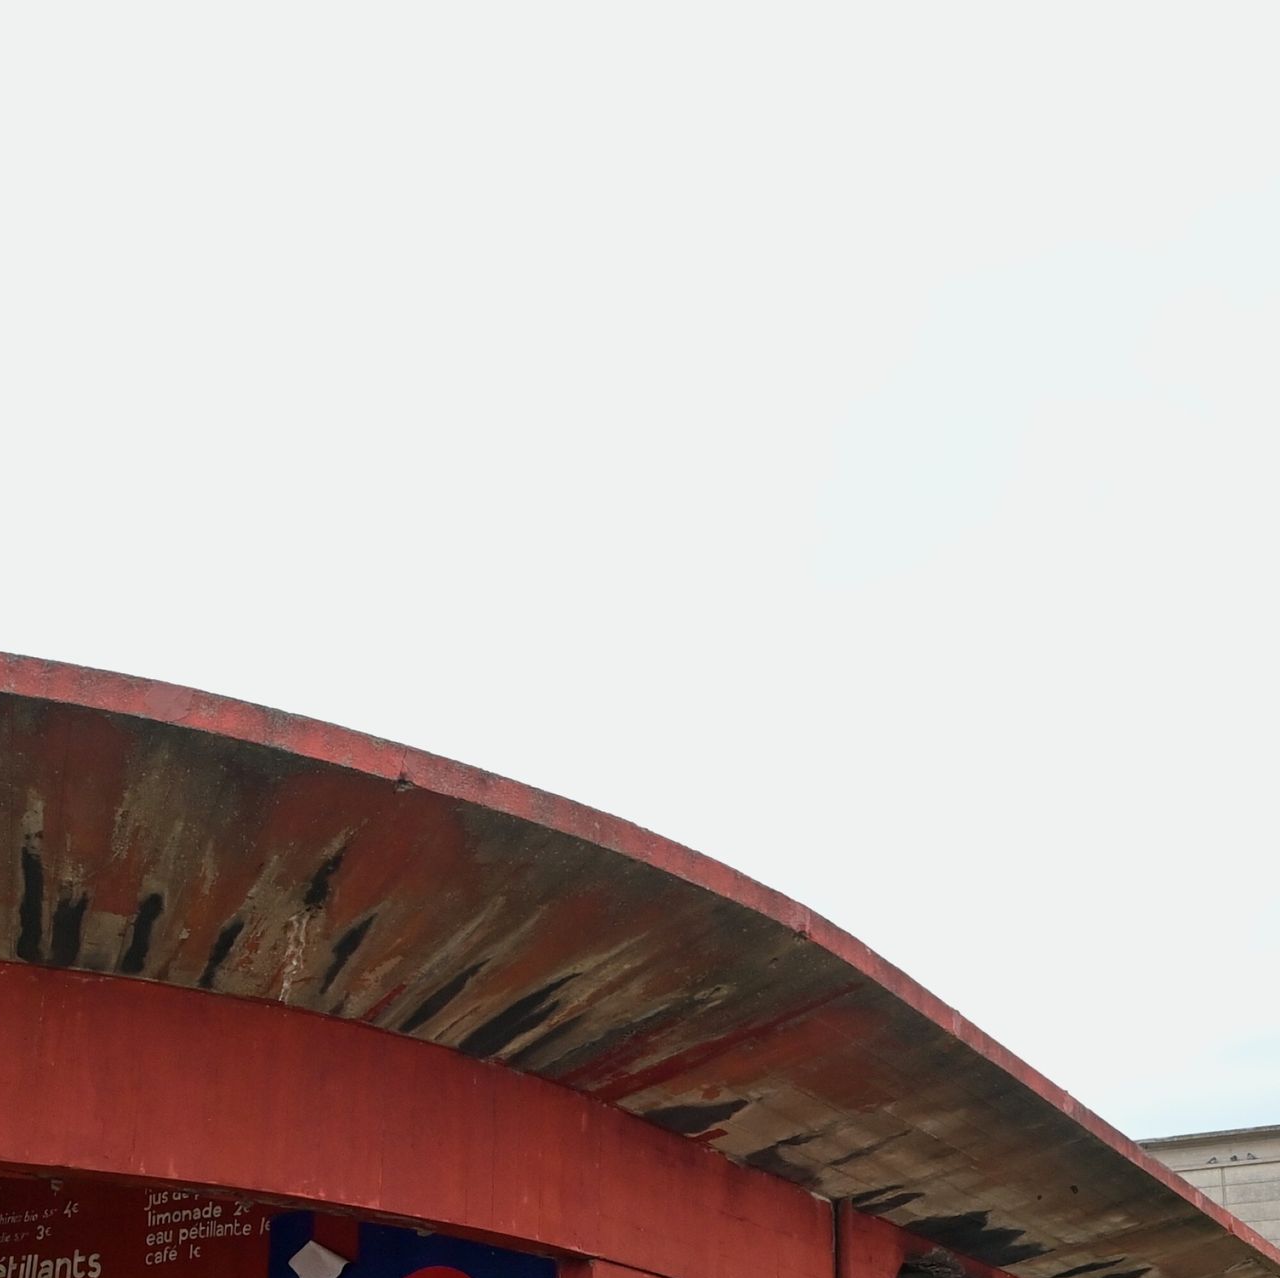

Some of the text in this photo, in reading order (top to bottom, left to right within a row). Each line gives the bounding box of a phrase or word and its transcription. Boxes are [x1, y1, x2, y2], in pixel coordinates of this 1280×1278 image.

[63, 1200, 80, 1218] 4€
[144, 1188, 168, 1211] jus
[147, 1201, 222, 1227] limonade
[35, 1224, 53, 1240] 3€
[146, 1230, 173, 1246] eau
[178, 1218, 252, 1245] pétillante
[145, 1245, 178, 1265] café
